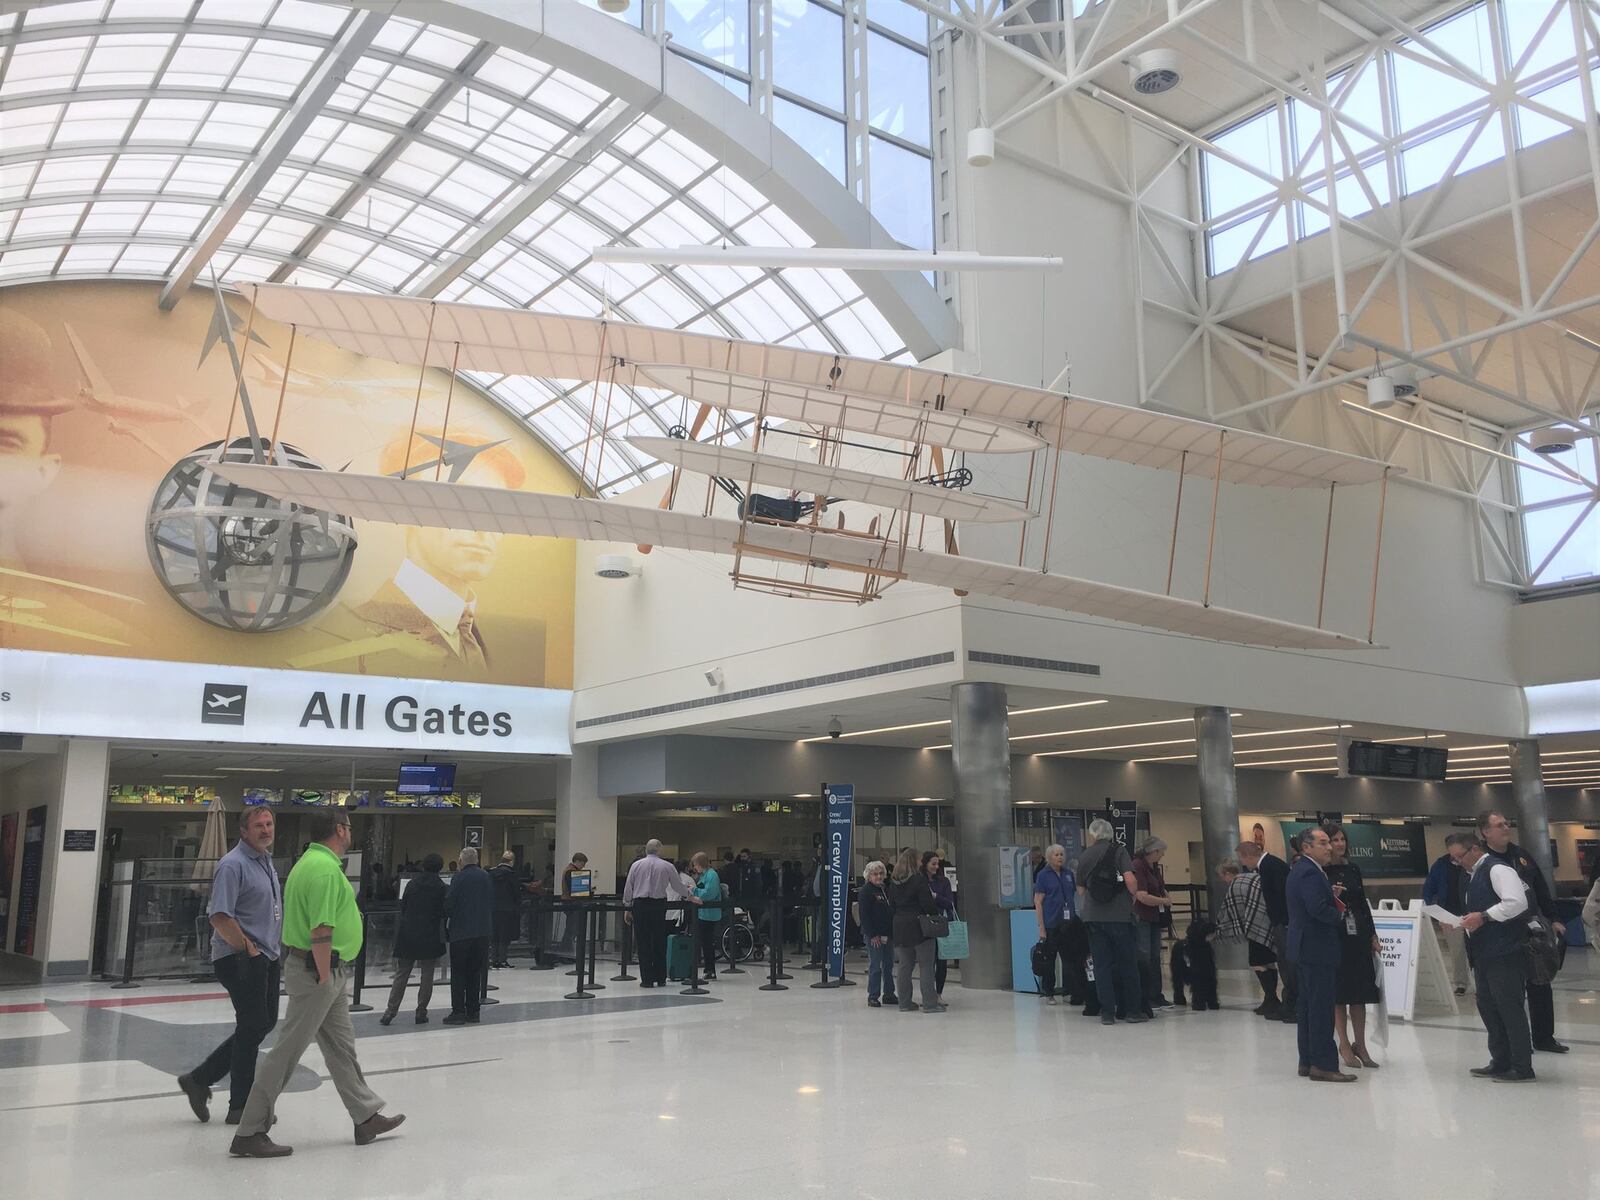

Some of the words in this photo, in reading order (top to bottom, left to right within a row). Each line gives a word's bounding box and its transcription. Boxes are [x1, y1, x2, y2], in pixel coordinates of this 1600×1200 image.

[298, 691, 367, 731] All
[384, 695, 513, 737] Gates
[470, 831, 479, 843] 2
[831, 832, 843, 954] Crew/Employees
